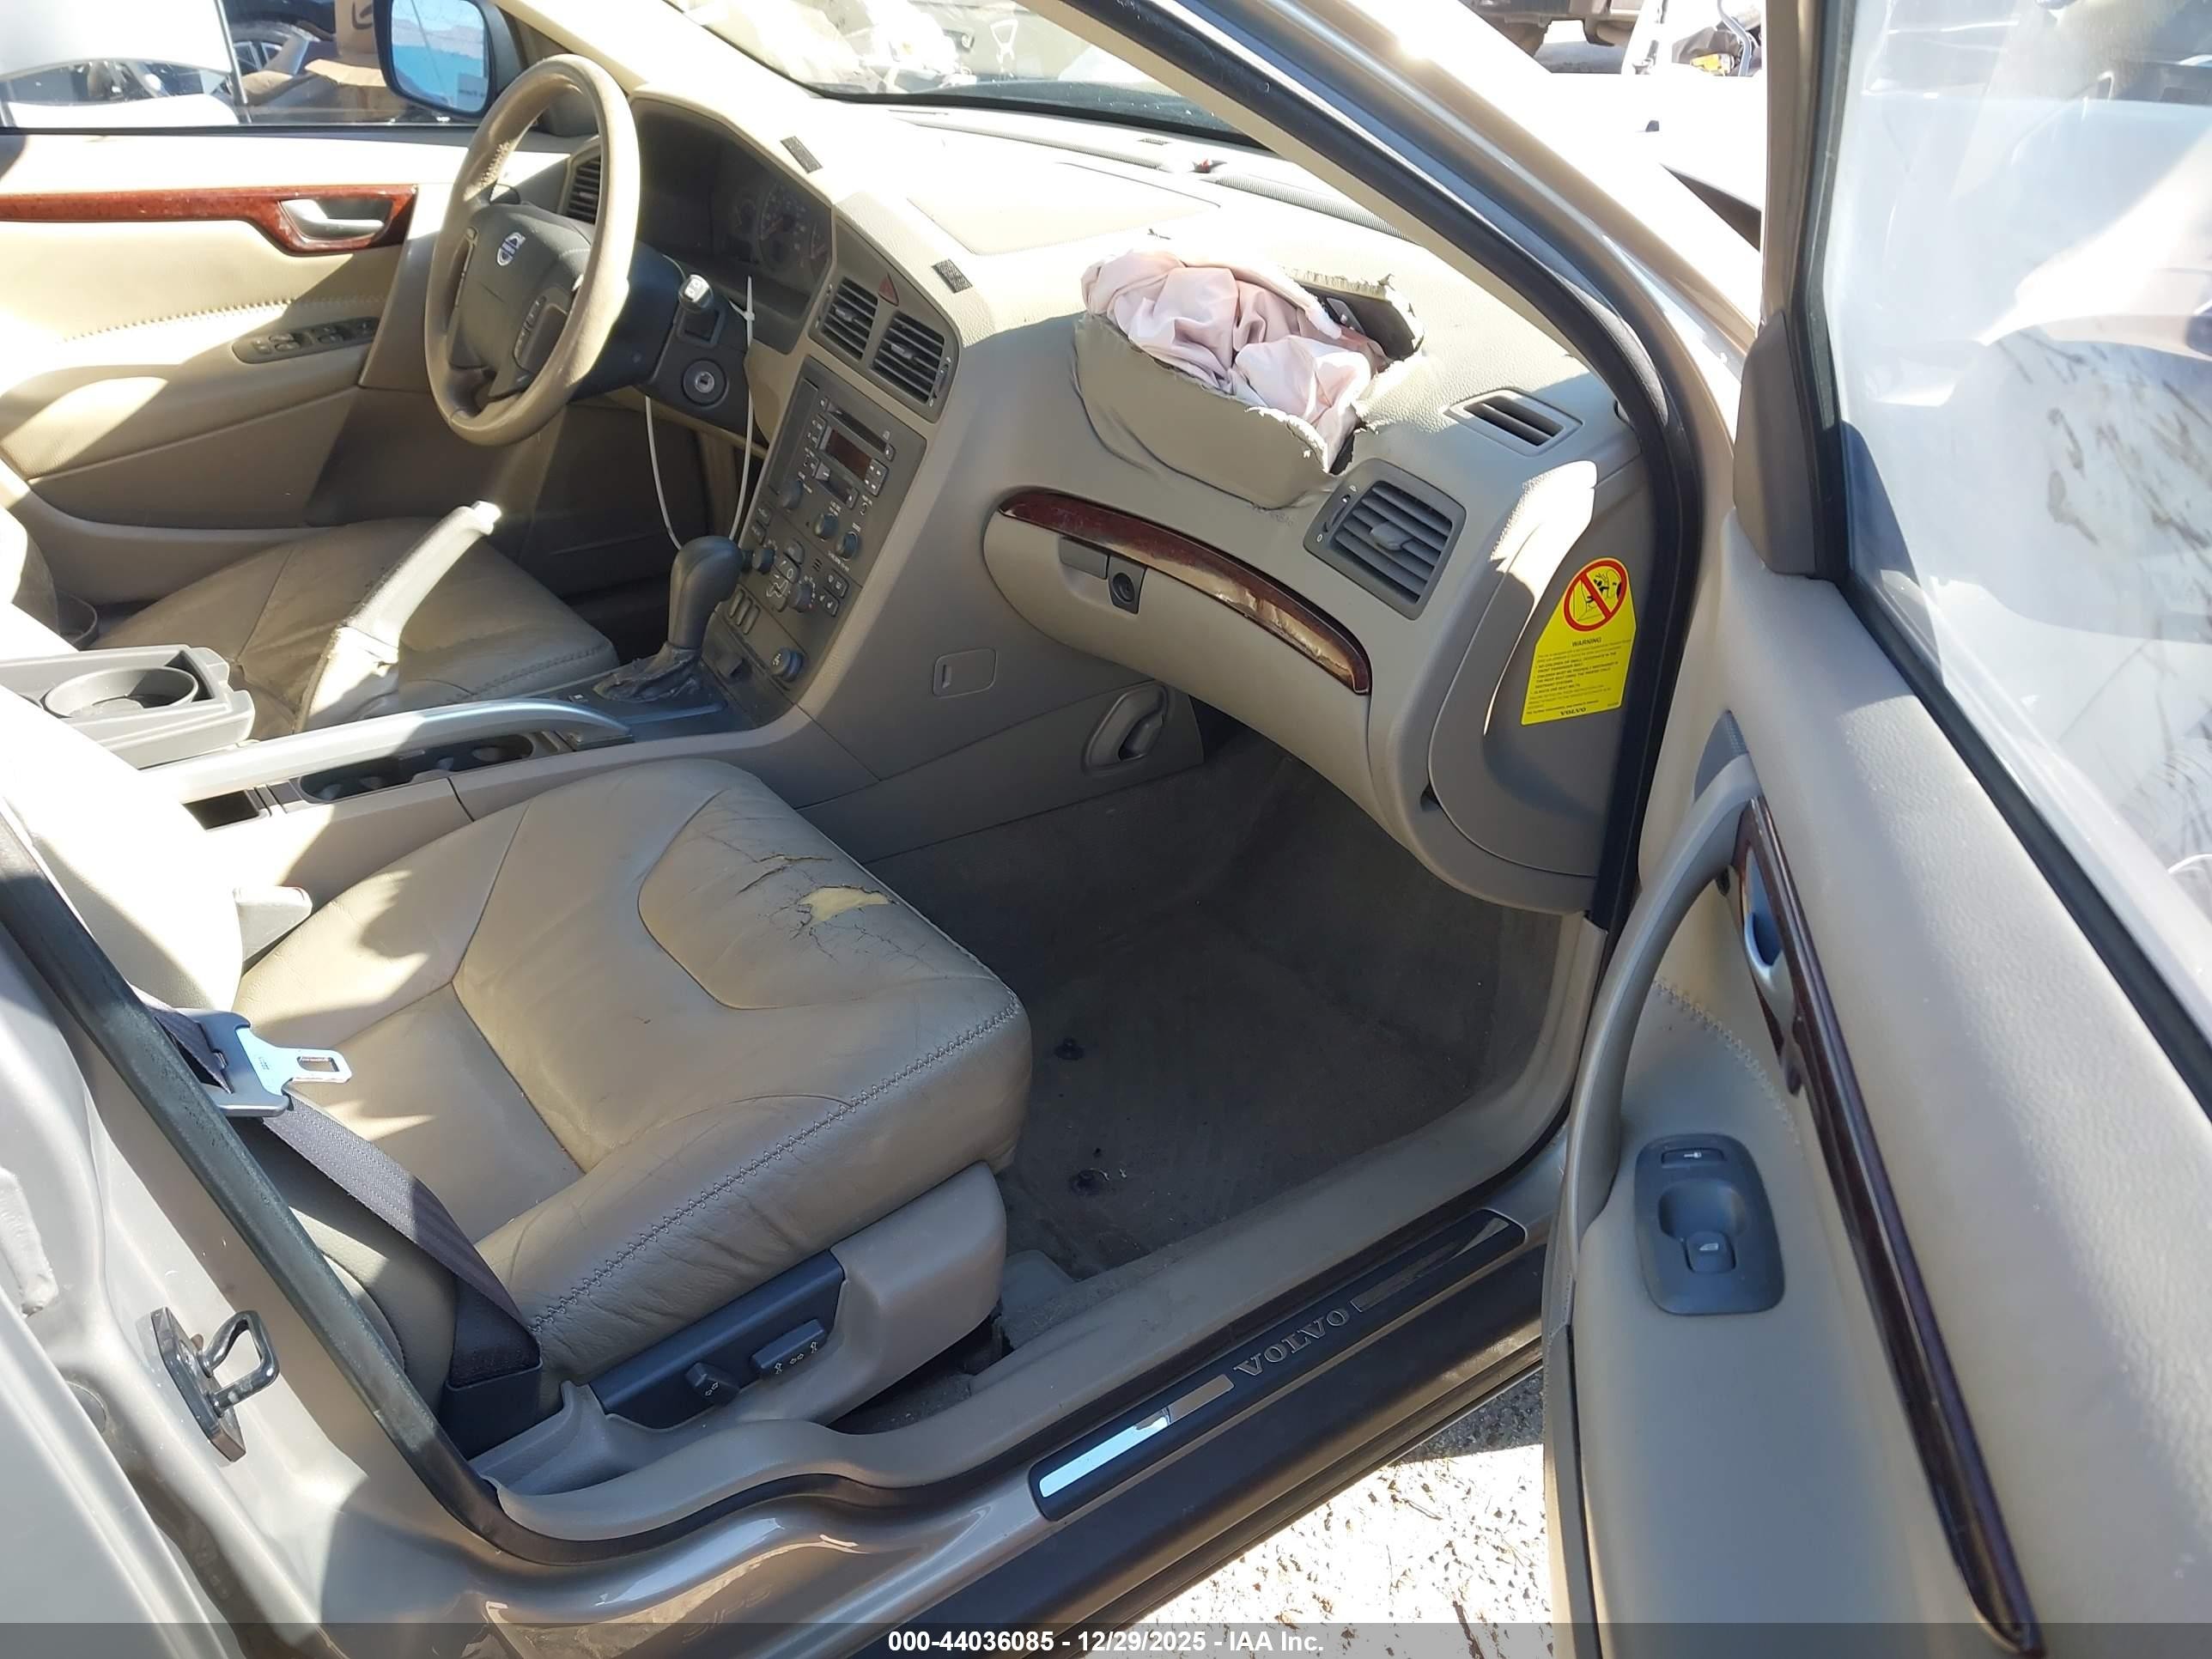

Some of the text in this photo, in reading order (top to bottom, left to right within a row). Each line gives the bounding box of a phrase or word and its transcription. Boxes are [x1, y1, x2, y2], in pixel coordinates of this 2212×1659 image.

[1571, 636, 1602, 647] WARNING
[1560, 707, 1587, 716] VOLVO
[1232, 1308, 1351, 1376] VOLVO
